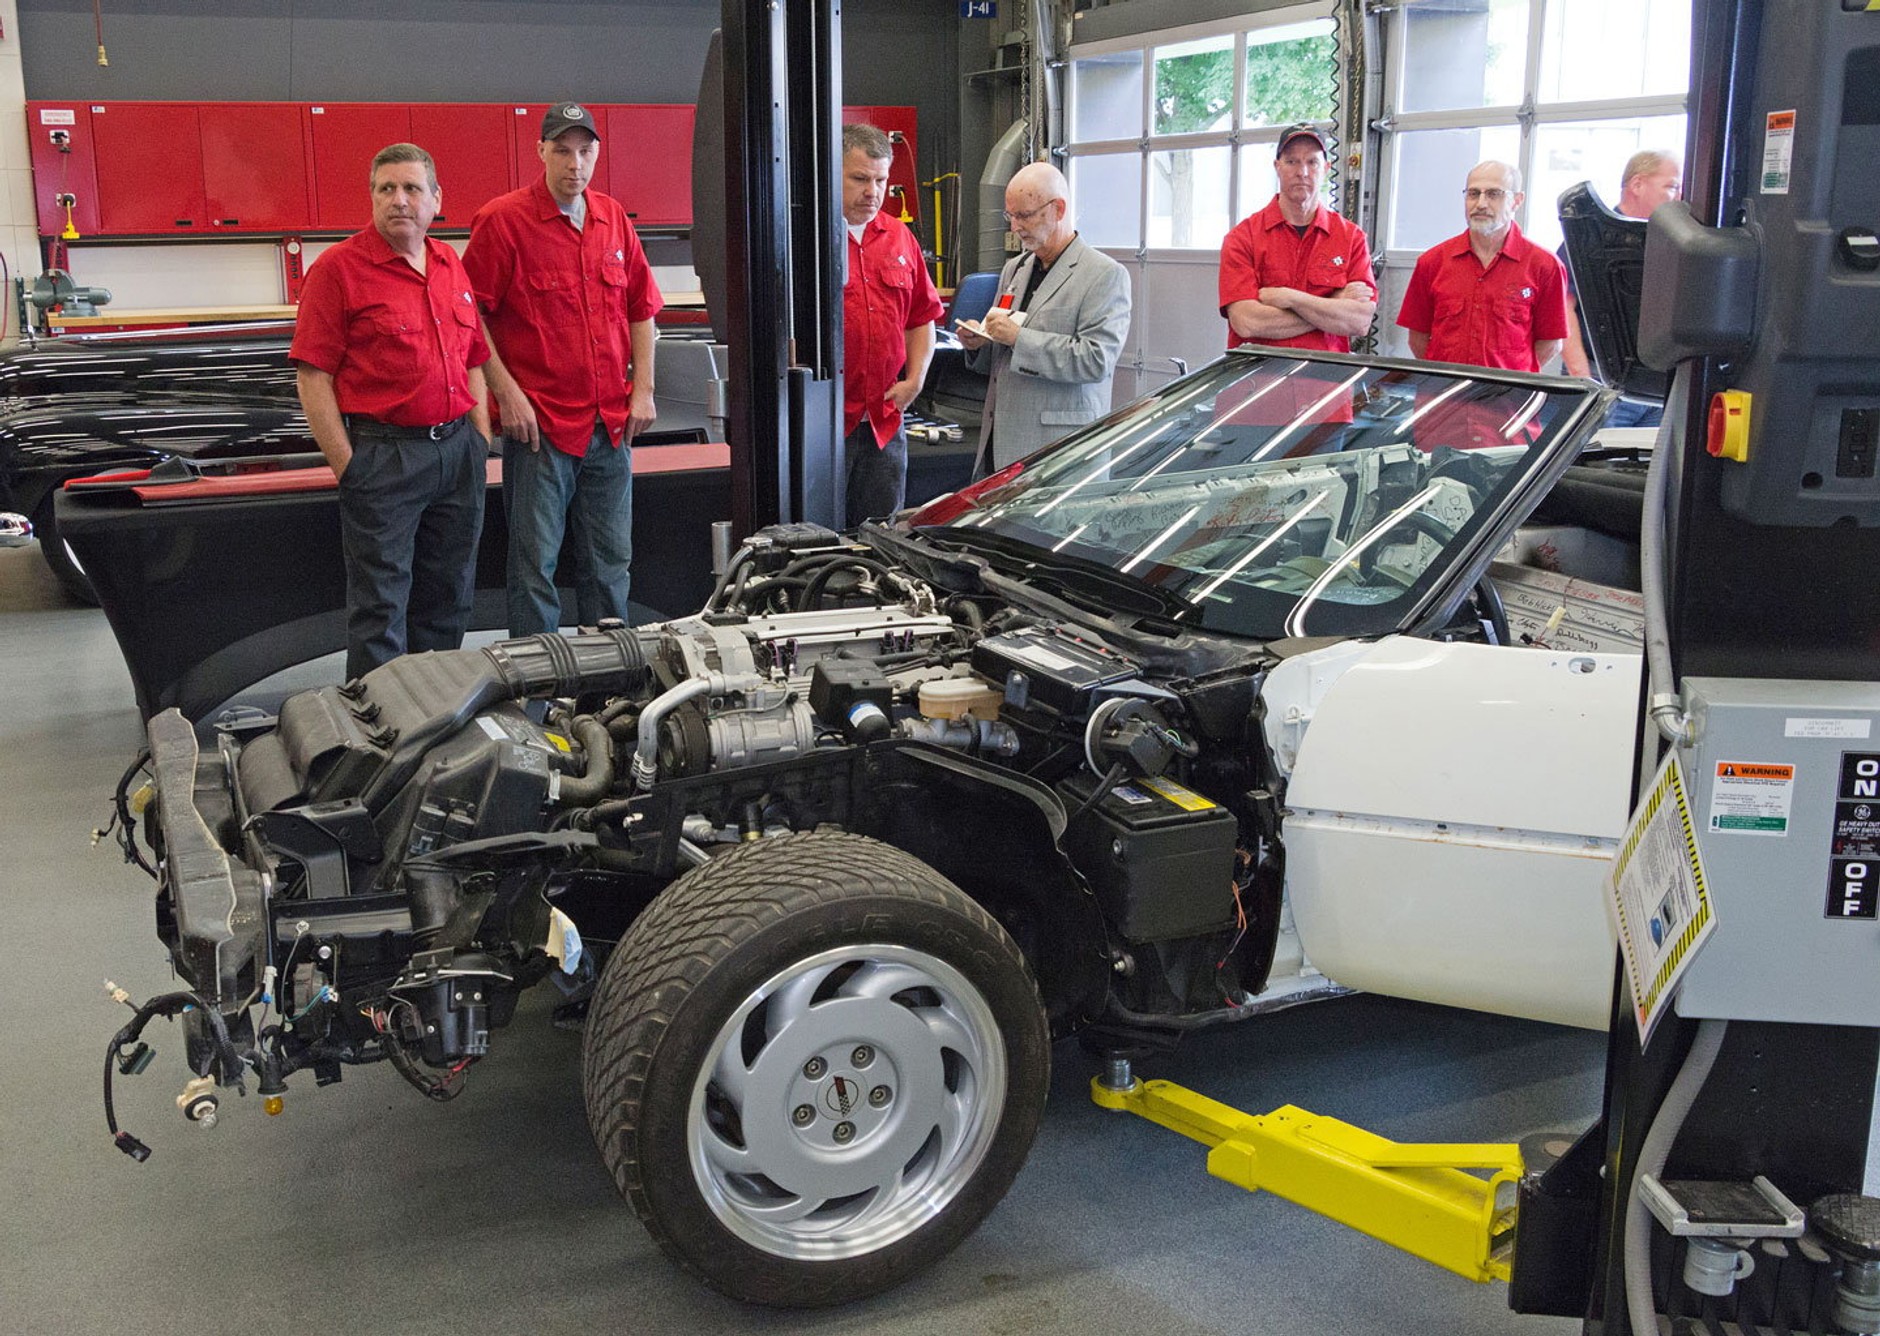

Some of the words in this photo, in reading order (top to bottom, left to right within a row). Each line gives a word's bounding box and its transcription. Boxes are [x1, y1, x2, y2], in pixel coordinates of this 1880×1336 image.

[1741, 767, 1790, 777] WARNING
[1854, 760, 1879, 796] ON
[1842, 863, 1867, 916] OFF
